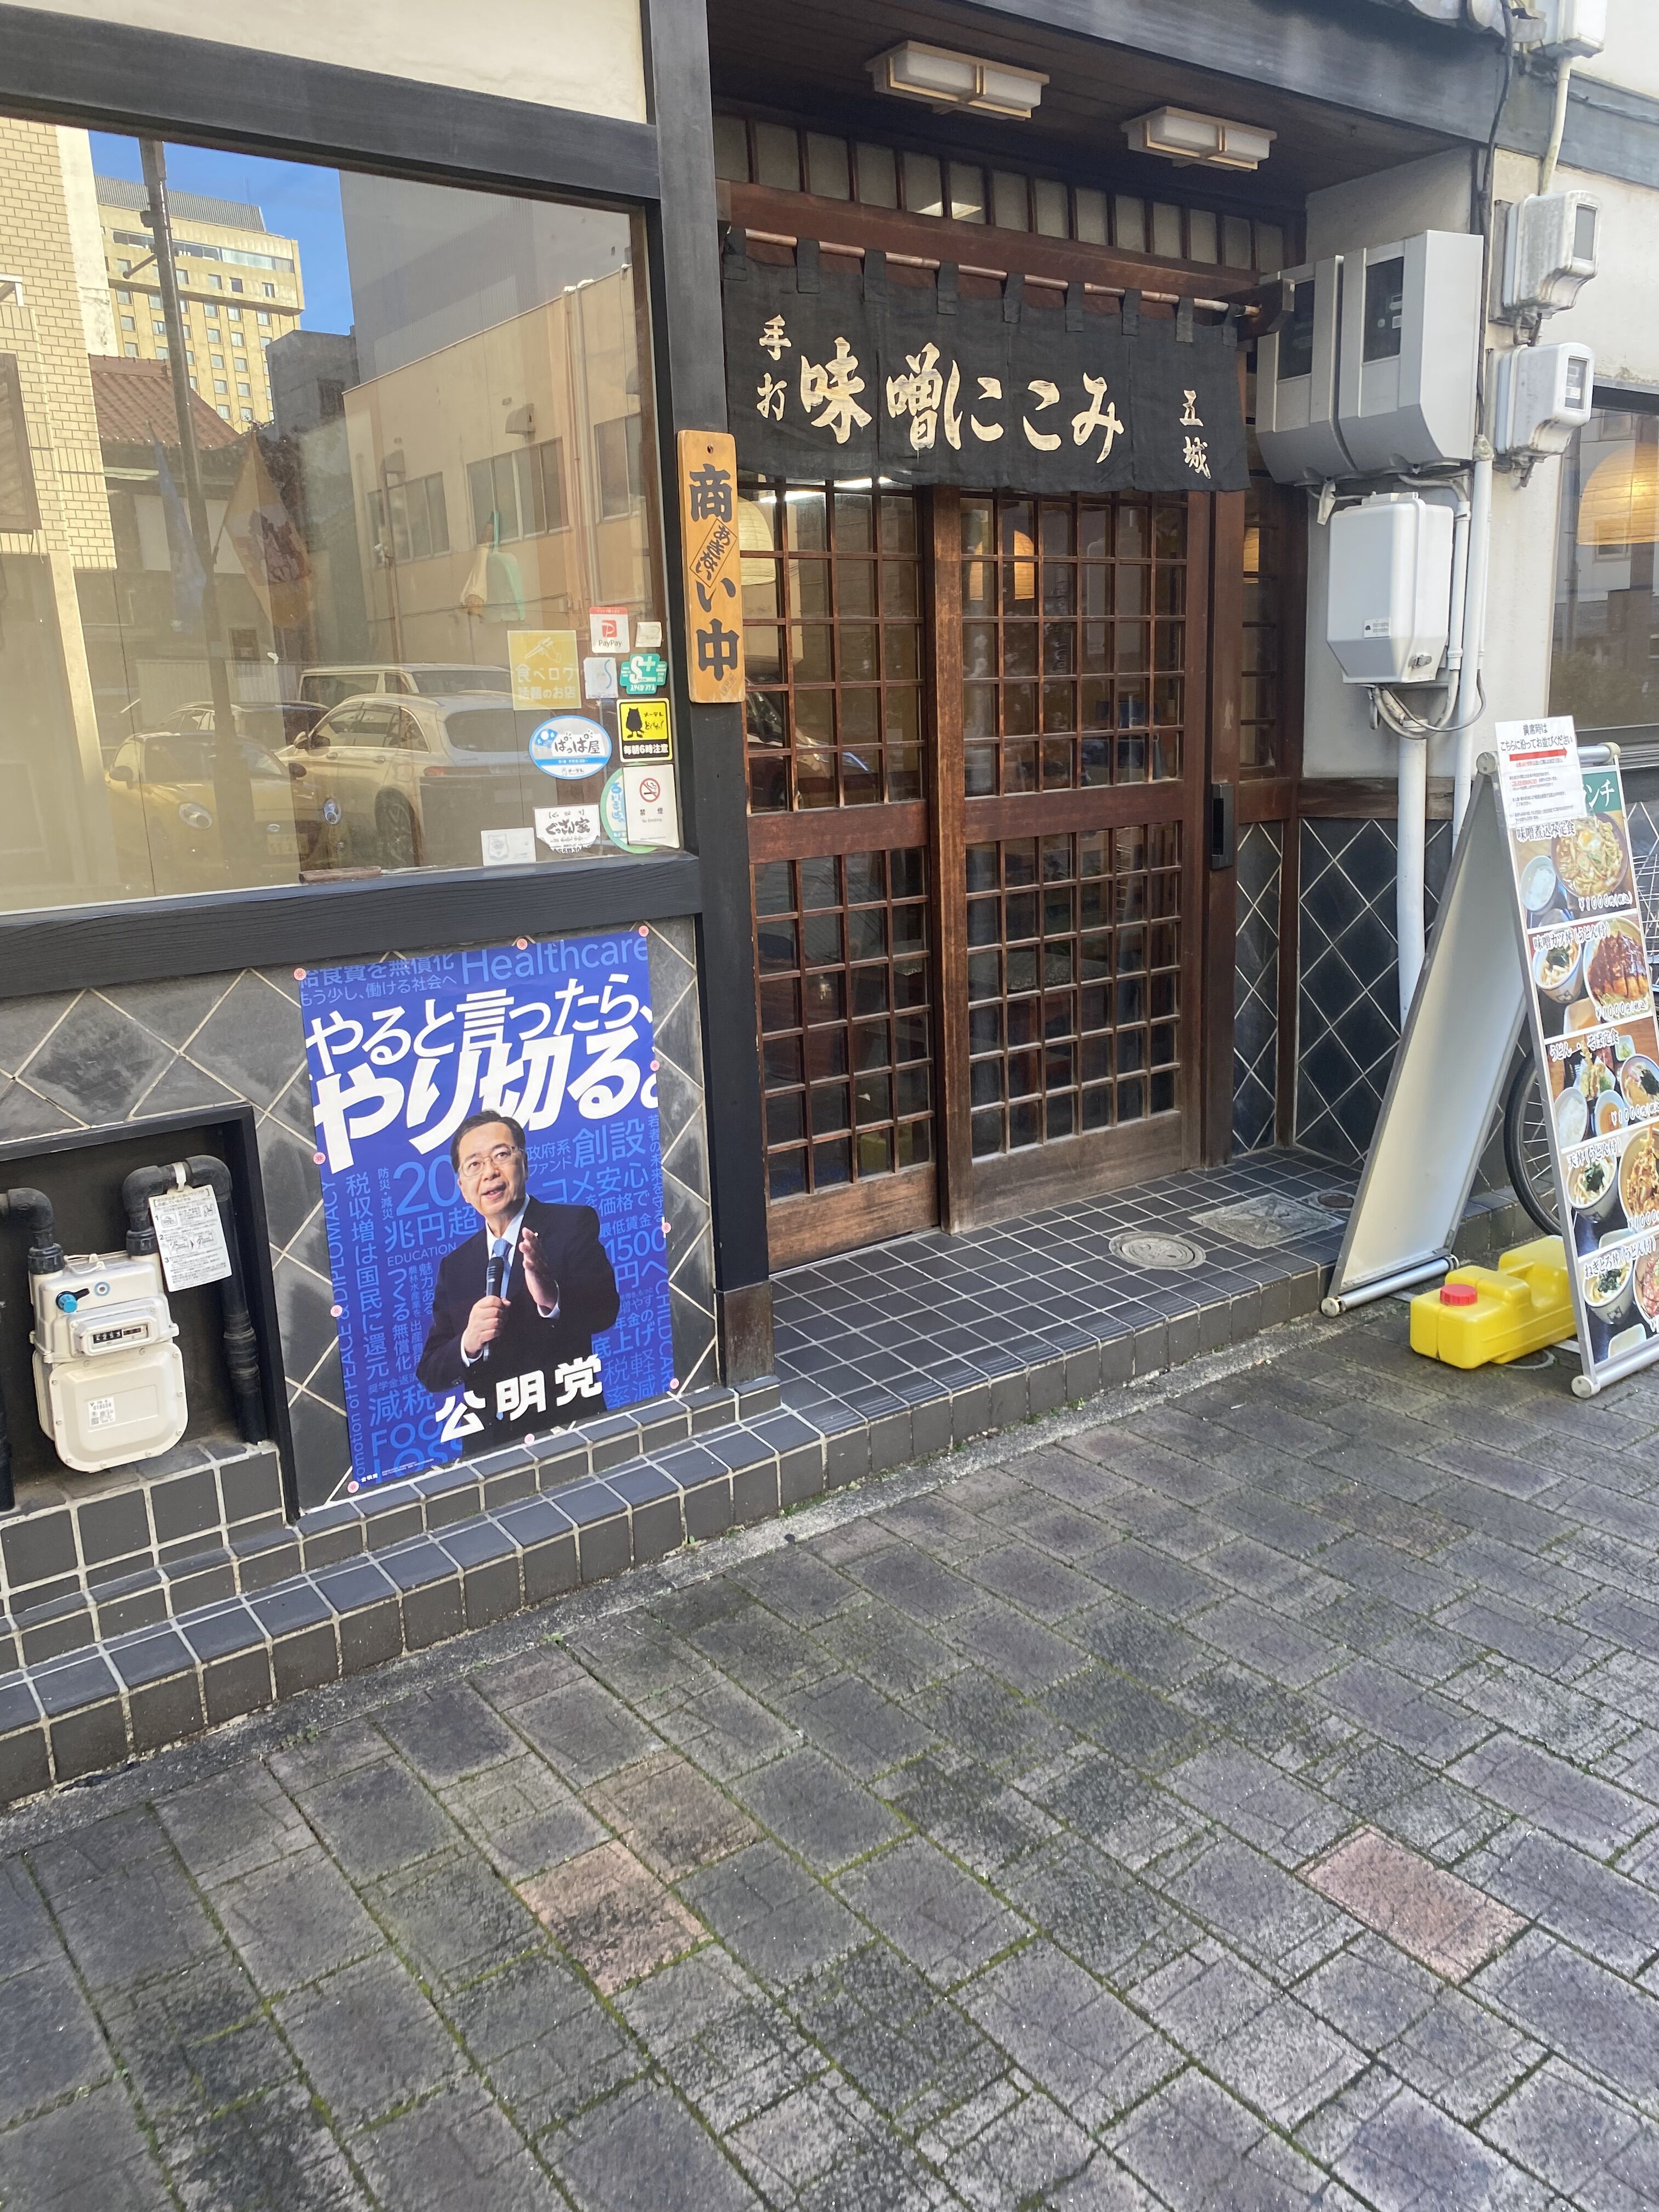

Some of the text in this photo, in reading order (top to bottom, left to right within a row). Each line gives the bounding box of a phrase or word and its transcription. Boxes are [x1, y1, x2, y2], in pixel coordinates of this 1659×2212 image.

[757, 314, 792, 421] 手打
[689, 463, 740, 681] 商い中
[599, 640, 622, 648] PayPay
[515, 663, 575, 682] 食べログ
[517, 686, 575, 701] 話題のお店
[1583, 779, 1615, 808] ンチ
[462, 938, 648, 985] Healthcare
[300, 974, 457, 1007] もう少し、働ける社会へ
[572, 1118, 646, 1169] 創設
[321, 1181, 348, 1305] DIPLOMACY
[385, 1205, 478, 1253] 兆円超
[599, 1213, 652, 1238] 最低賃金
[1628, 1209, 1659, 1231] ¥1000
[346, 1171, 389, 1381] 税収増は国民に還元
[387, 1242, 456, 1267] EDUCATION
[387, 1268, 410, 1322] つくる
[419, 1261, 436, 1315] 魅力ある
[592, 1321, 655, 1359] 底上げ
[613, 1310, 653, 1330] 年金の
[338, 1323, 357, 1391] PEACE
[392, 1323, 411, 1373] 無償化
[435, 1353, 603, 1443] 公明党
